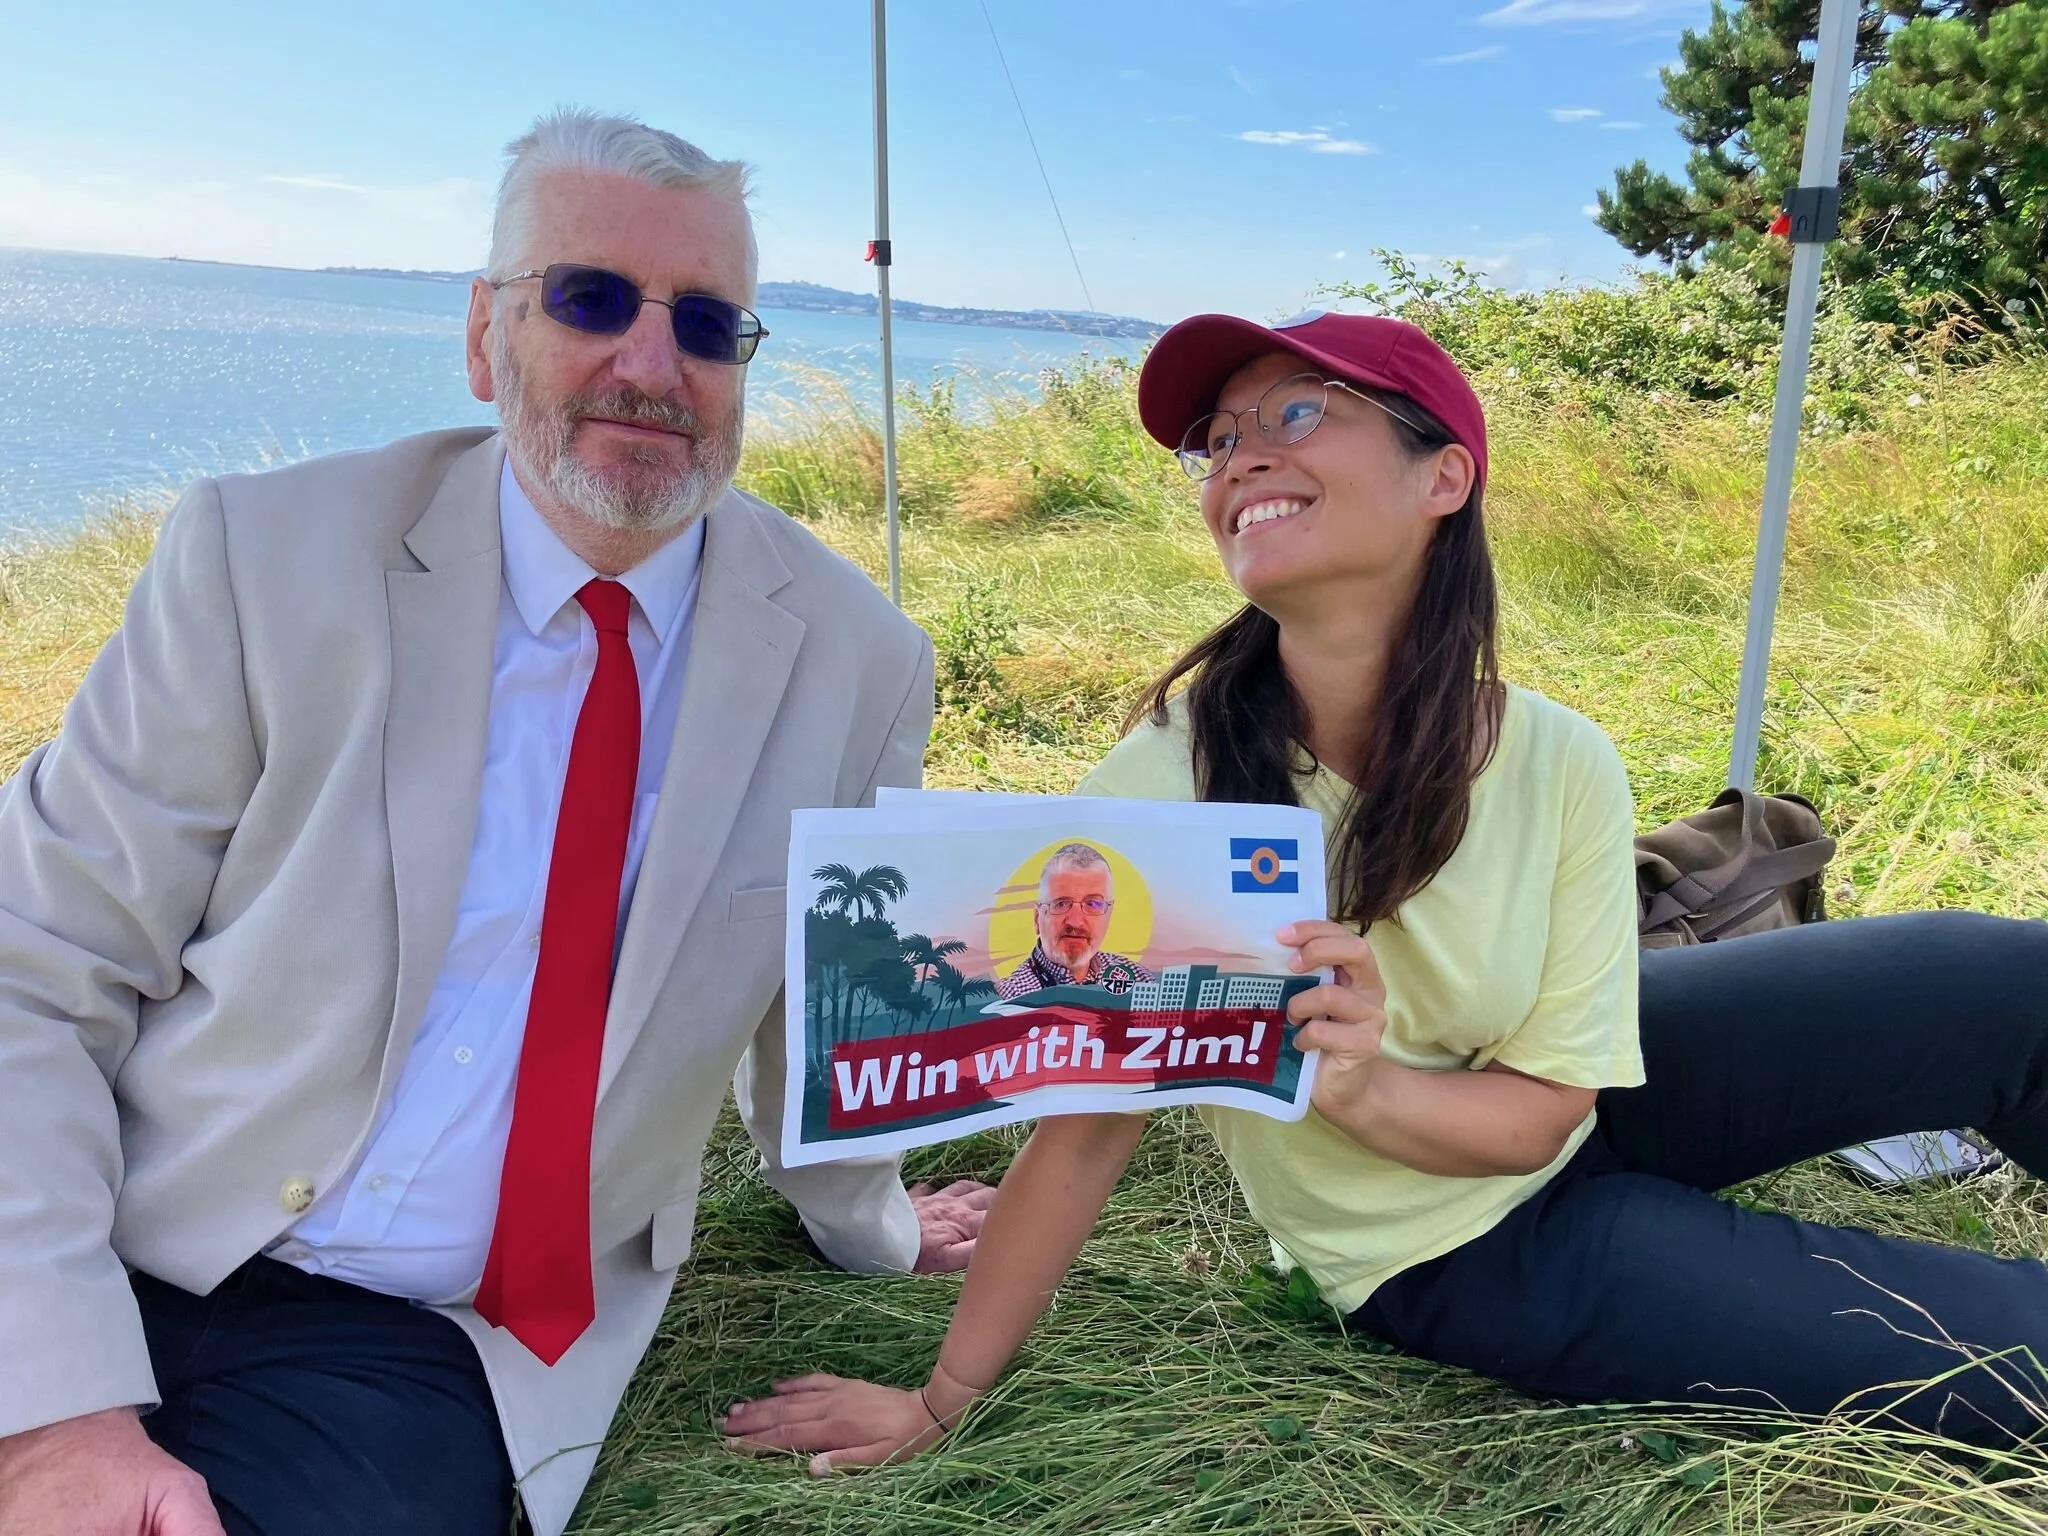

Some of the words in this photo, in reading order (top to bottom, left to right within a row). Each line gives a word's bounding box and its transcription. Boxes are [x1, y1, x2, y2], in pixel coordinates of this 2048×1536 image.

[834, 1051, 958, 1112] Win
[974, 1024, 1105, 1085] with
[1120, 1021, 1267, 1070] Zim!
